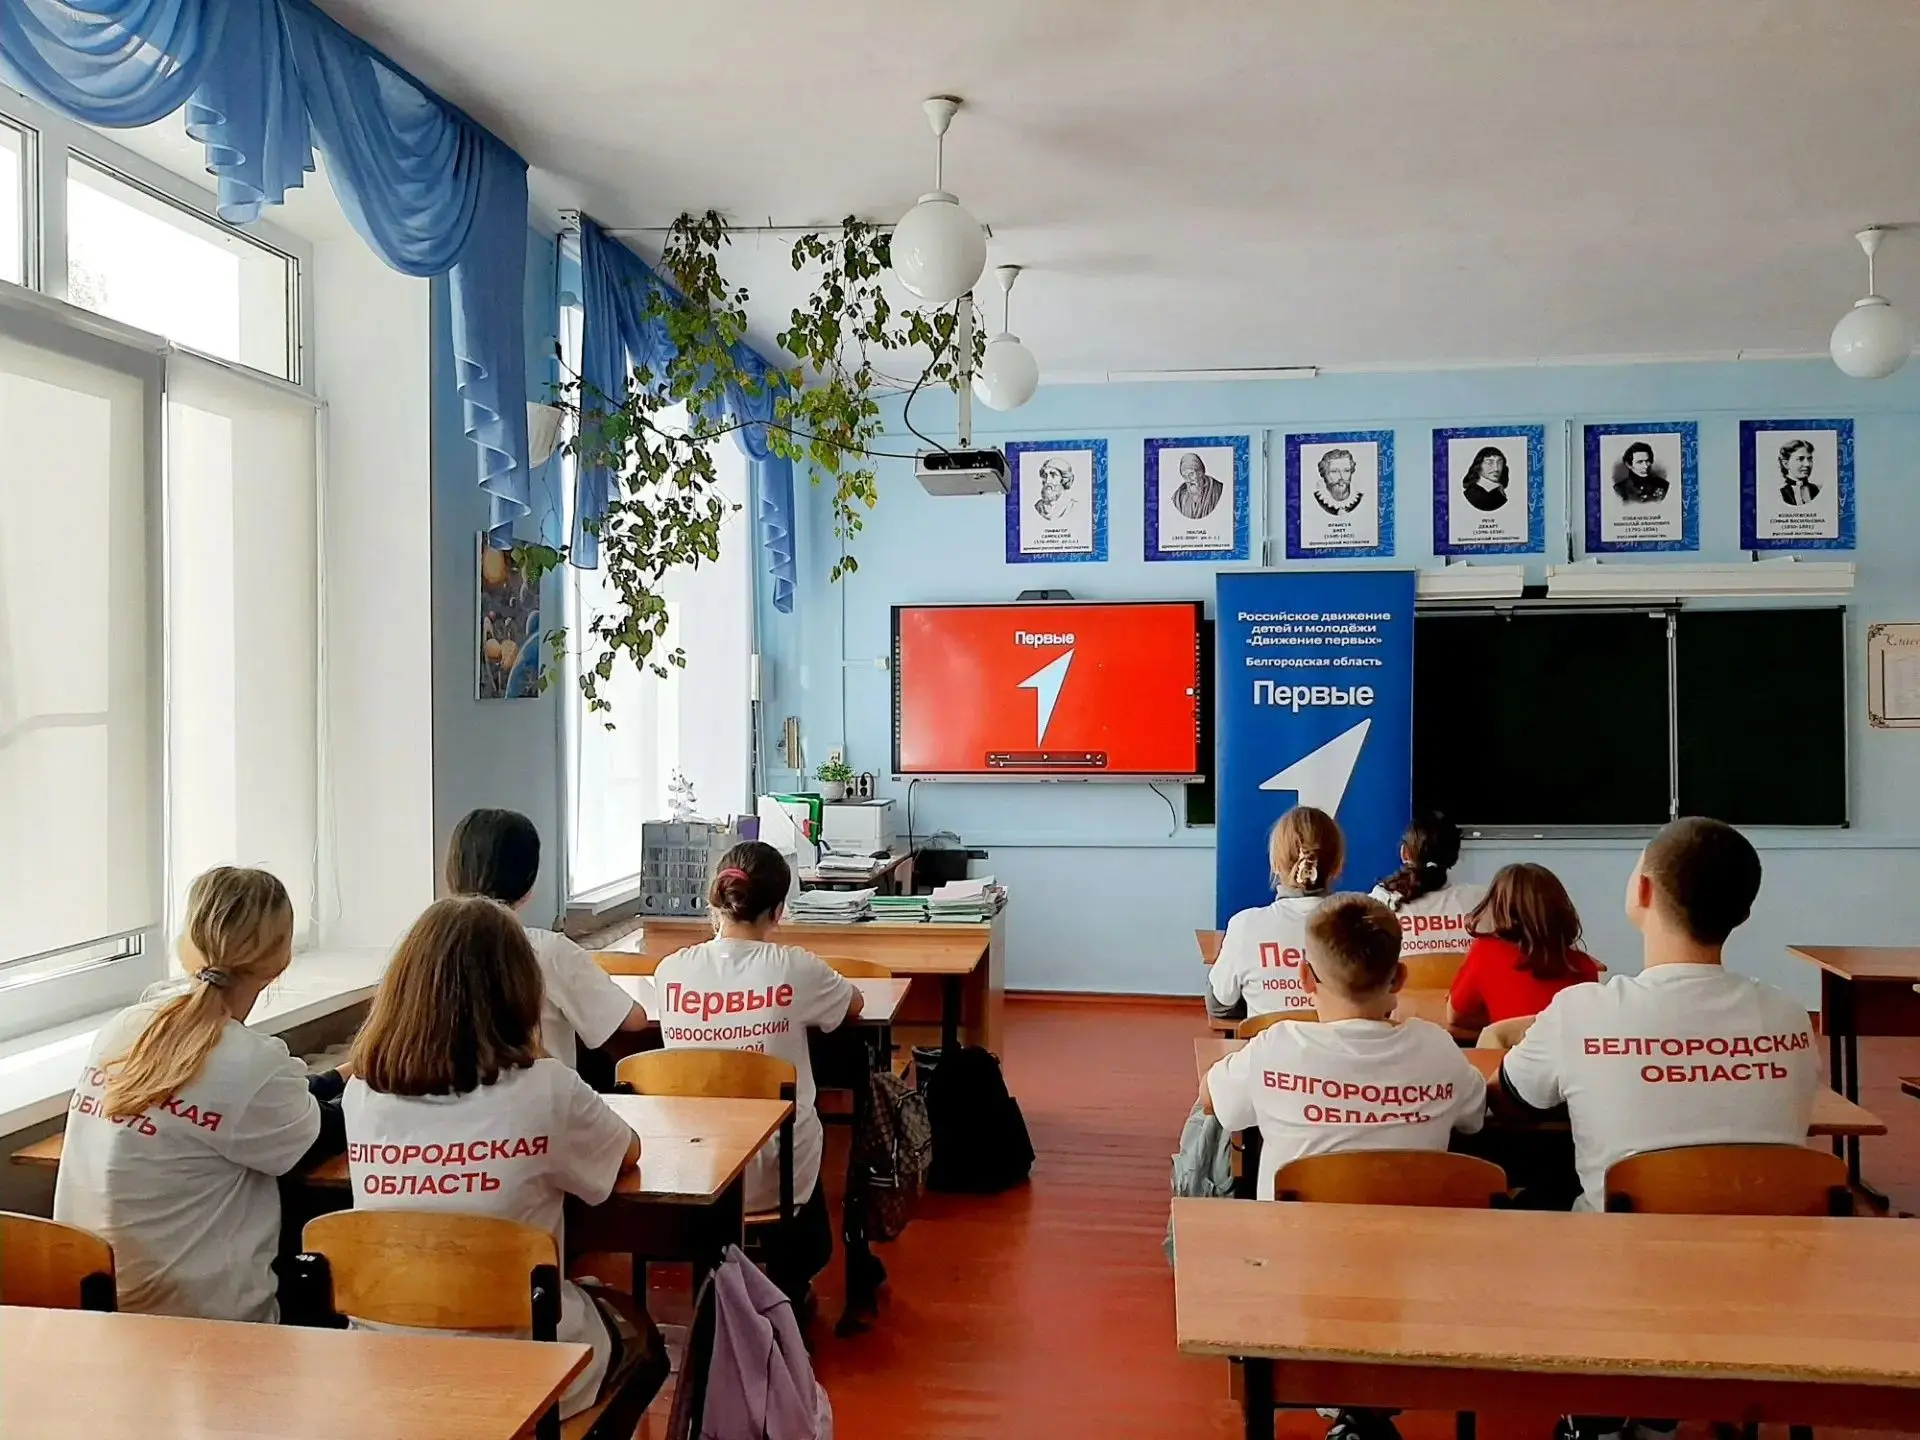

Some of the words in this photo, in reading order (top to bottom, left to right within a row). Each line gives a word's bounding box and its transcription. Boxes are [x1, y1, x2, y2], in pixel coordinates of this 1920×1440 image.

[1237, 611, 1320, 622] Российское
[1320, 612, 1391, 622] движение
[1251, 624, 1292, 634] детей
[1293, 625, 1303, 633] и
[1305, 623, 1377, 634] молодёжи
[1015, 631, 1075, 649] Первые
[1245, 635, 1323, 646] «Движение
[1324, 636, 1383, 647] первых»
[1245, 656, 1330, 668] Белгородская
[1332, 656, 1383, 667] область
[1253, 680, 1375, 713] Первые
[1400, 913, 1463, 936] ервы
[1402, 938, 1472, 951] ООСКОЛЬСКИ
[666, 982, 794, 1022] Первые
[1583, 1031, 1810, 1057] БЕЛГОРОДСКАЯ
[1640, 1062, 1788, 1083] ОБЛАСТЬ
[1263, 1070, 1454, 1106] БЕЛГОРОДСКАЯ
[350, 1135, 550, 1167] ЕЛГОРОДСКАЯ
[363, 1171, 501, 1196] ОБЛАСТЬ
